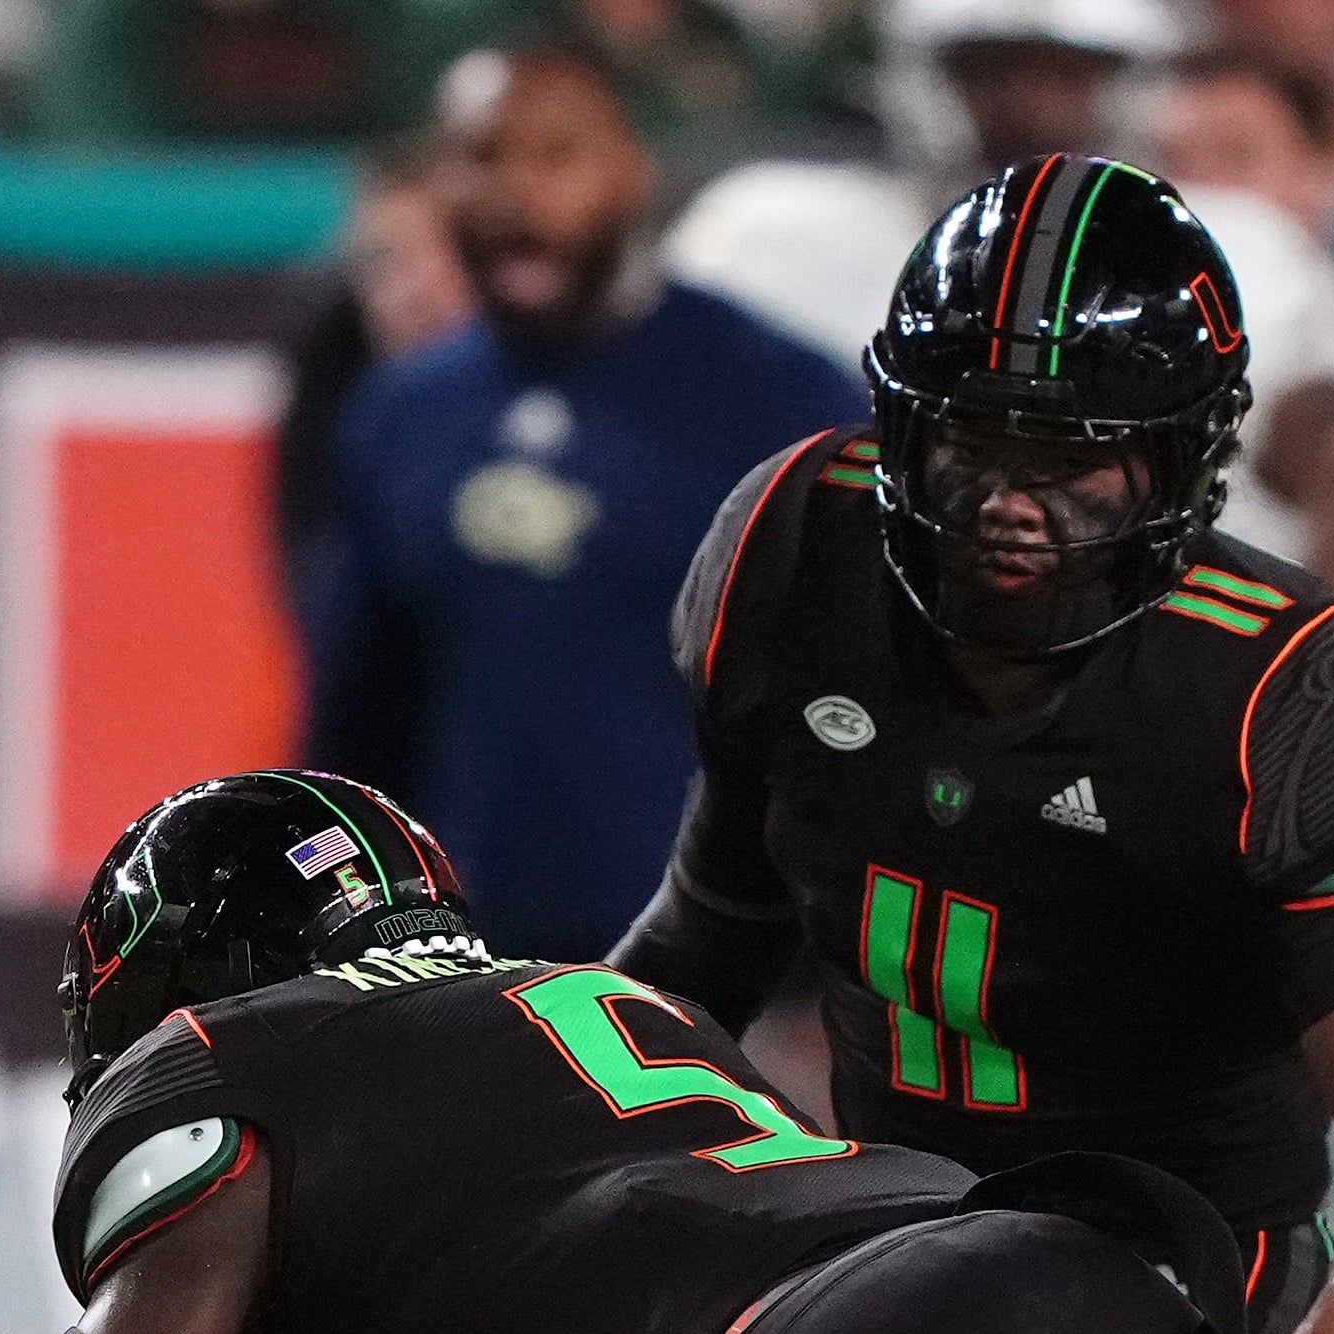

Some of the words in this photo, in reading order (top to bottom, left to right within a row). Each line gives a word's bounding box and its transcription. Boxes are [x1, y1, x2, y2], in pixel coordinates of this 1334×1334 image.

[334, 864, 371, 909] 5
[860, 863, 1027, 1112] 11
[502, 963, 860, 1174] 5
